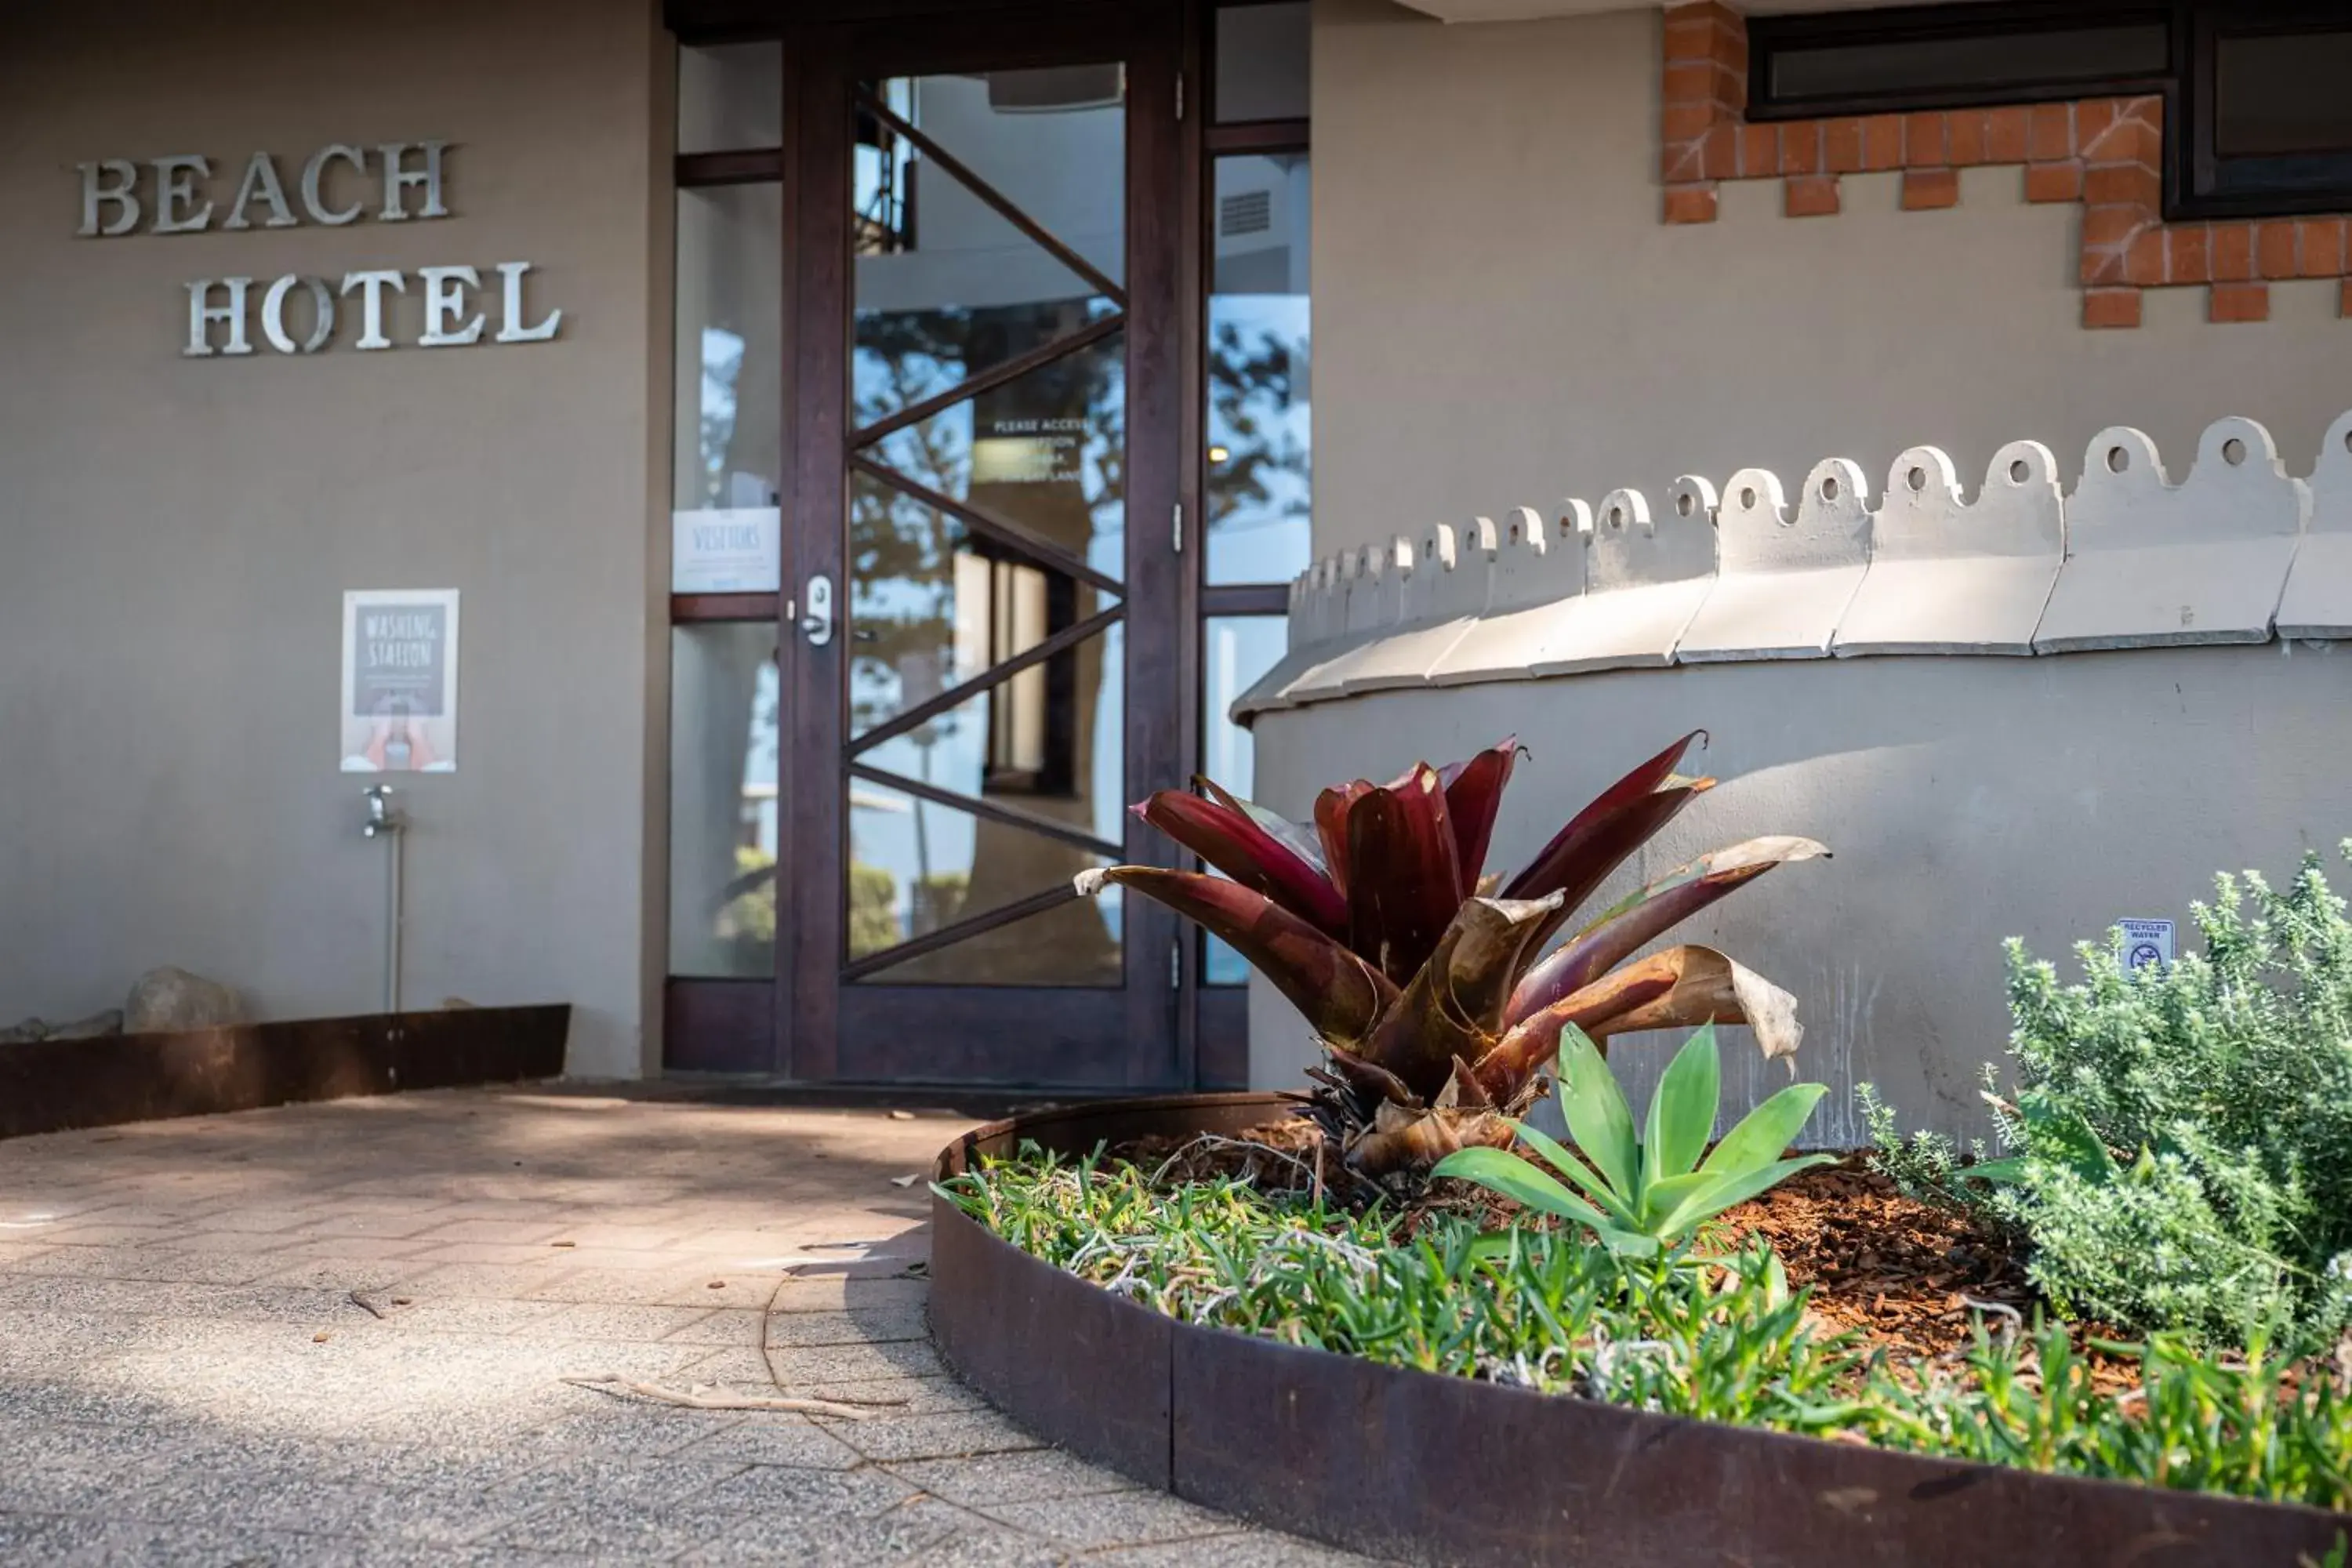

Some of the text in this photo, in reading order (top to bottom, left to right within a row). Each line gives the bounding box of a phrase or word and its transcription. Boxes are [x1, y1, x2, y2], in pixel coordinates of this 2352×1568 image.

[77, 140, 451, 235] BEACH
[183, 261, 561, 357] HOTEL
[994, 419, 1038, 432] PLEASE
[692, 524, 760, 551] VISITORS
[365, 614, 438, 641] WASHING
[368, 640, 431, 668] STATION
